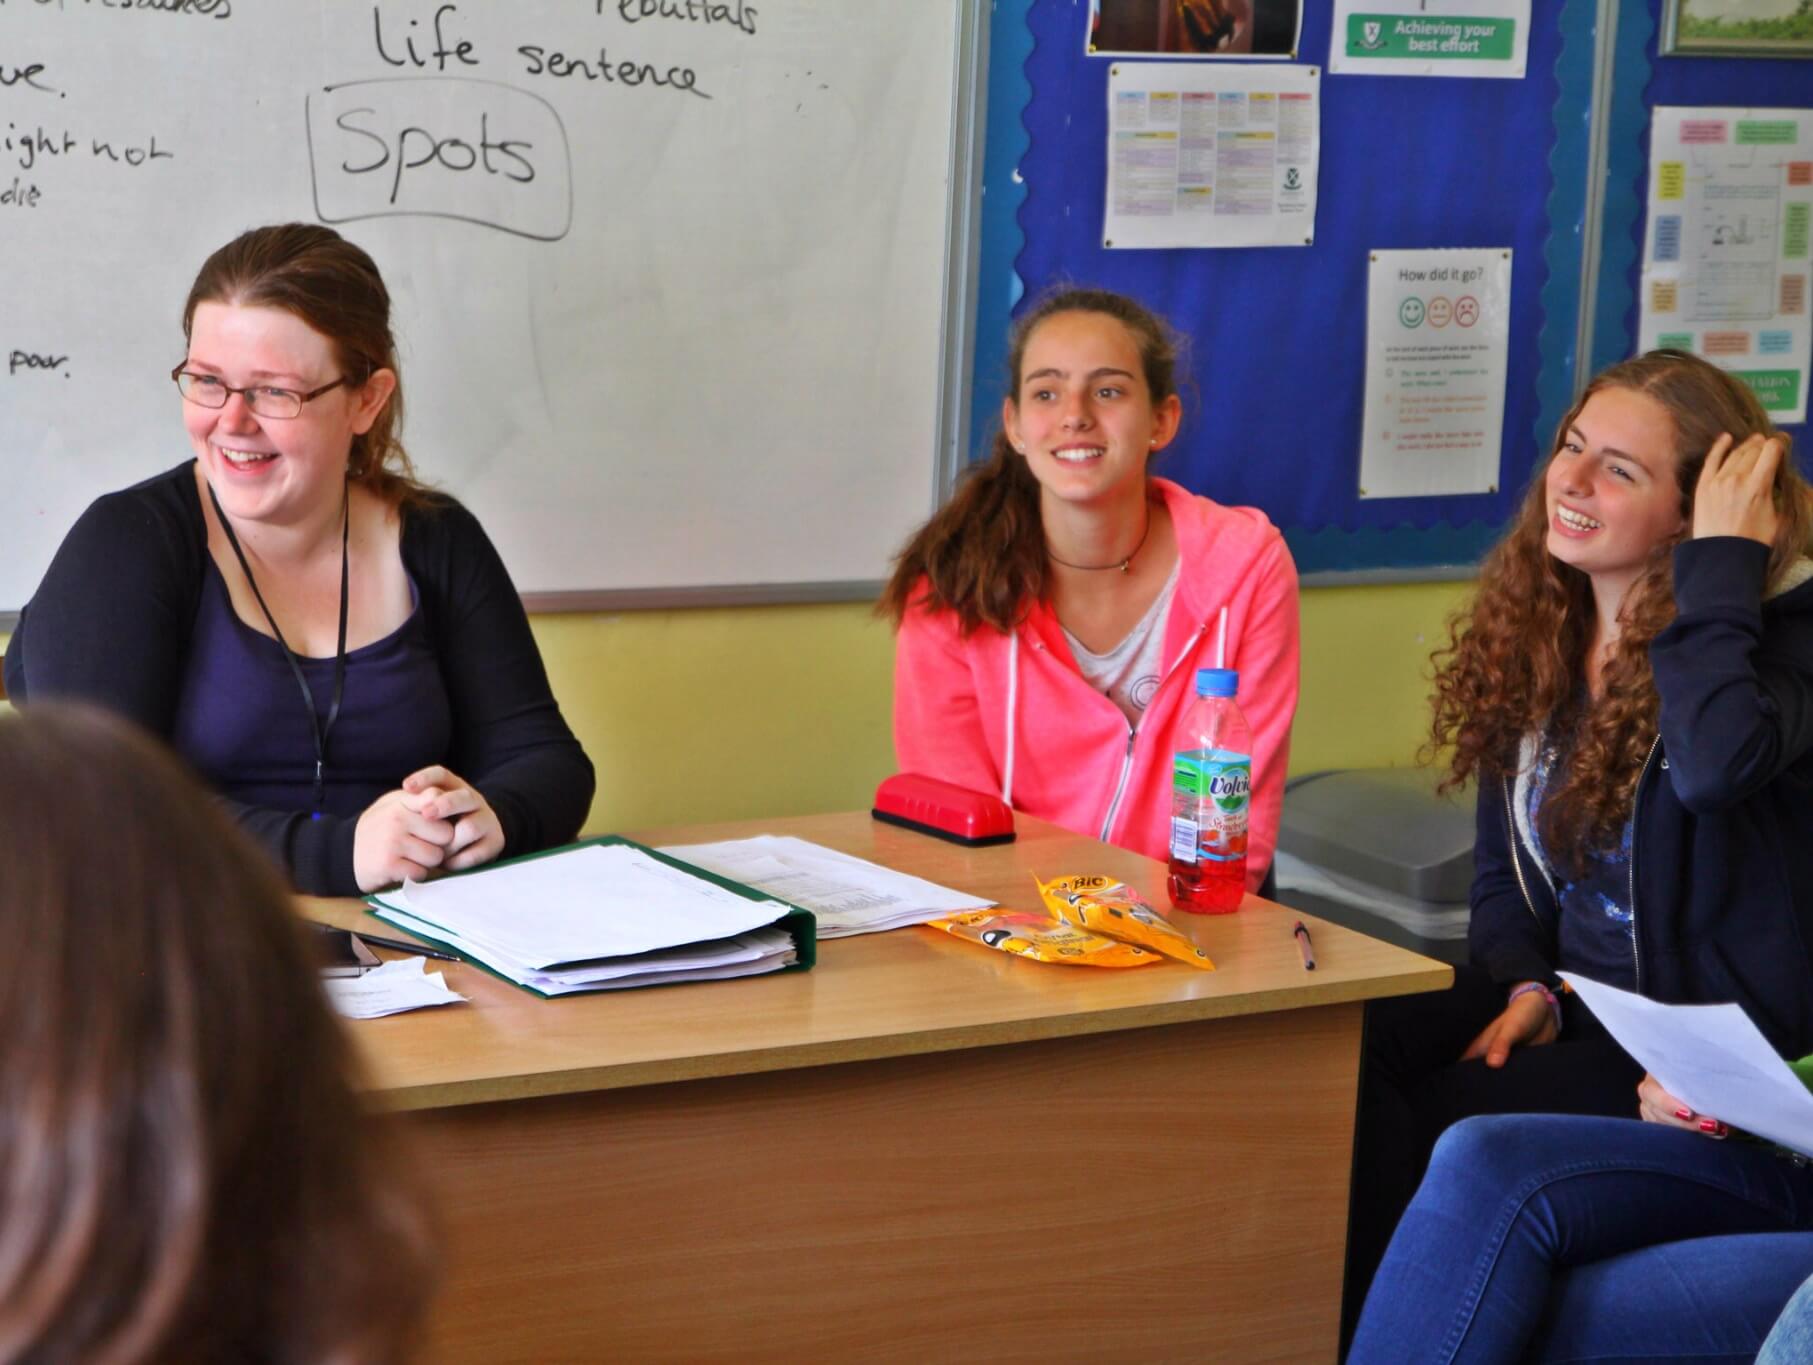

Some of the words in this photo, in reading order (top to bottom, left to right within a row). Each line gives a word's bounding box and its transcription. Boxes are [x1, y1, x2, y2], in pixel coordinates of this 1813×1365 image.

[1394, 20, 1461, 40] Achieving
[1464, 24, 1496, 39] your
[1408, 37, 1439, 52] best
[1440, 38, 1480, 53] effort
[518, 46, 712, 101] sentence
[0, 123, 76, 169] ight
[92, 136, 174, 166] not
[336, 107, 536, 204] Spots
[1398, 268, 1427, 283] How
[1429, 267, 1449, 282] did
[1450, 267, 1460, 281] it
[1461, 266, 1484, 284] go?
